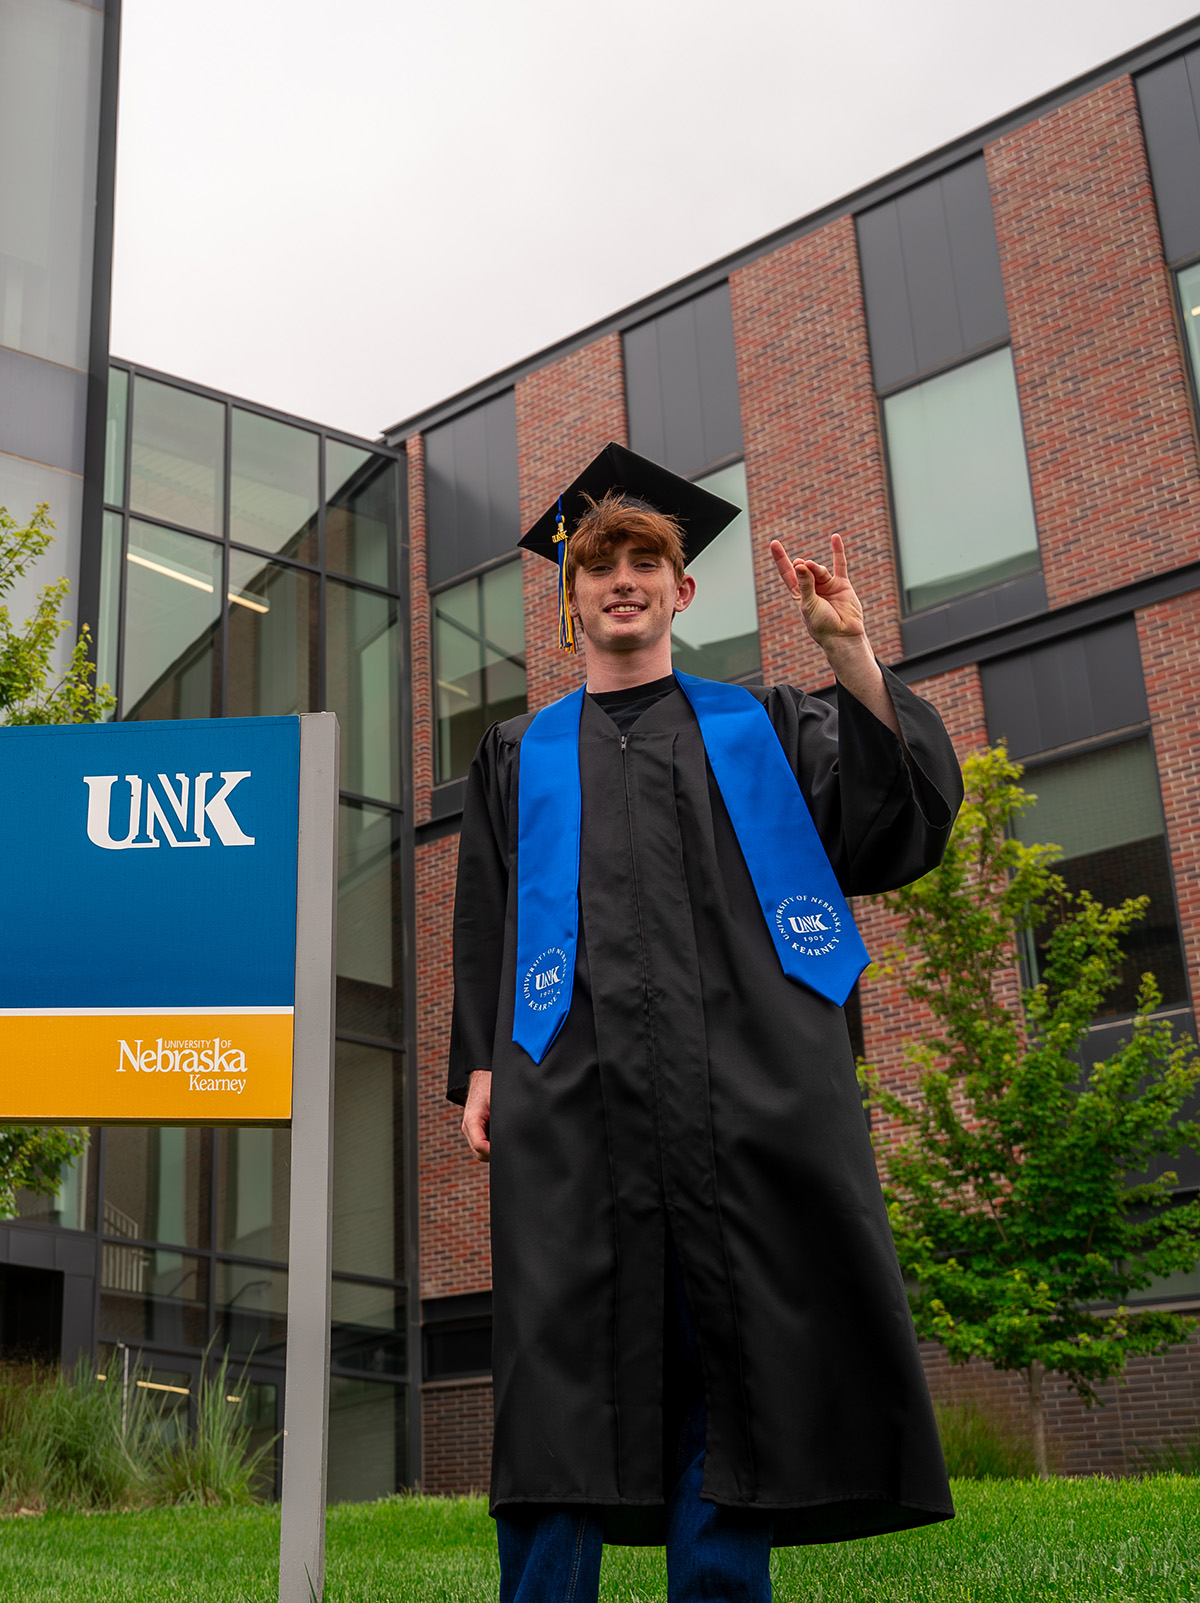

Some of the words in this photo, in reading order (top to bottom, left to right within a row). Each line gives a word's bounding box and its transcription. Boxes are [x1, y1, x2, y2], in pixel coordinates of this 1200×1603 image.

[82, 770, 256, 850] UNK
[776, 896, 795, 940] UNIVERSITY
[810, 896, 841, 933] NEBRASKA
[787, 913, 829, 934] UNK
[791, 936, 840, 956] KEARNEY
[803, 934, 824, 943] 1905
[523, 952, 546, 999] UNIVERSITY
[547, 946, 556, 955] OF
[535, 965, 561, 990] UNK
[528, 988, 561, 1011] KEARNEY
[115, 1037, 248, 1073] Nebraska
[164, 1040, 212, 1049] UNIVERSITY
[220, 1040, 233, 1049] OF
[188, 1074, 247, 1094] Kearney
